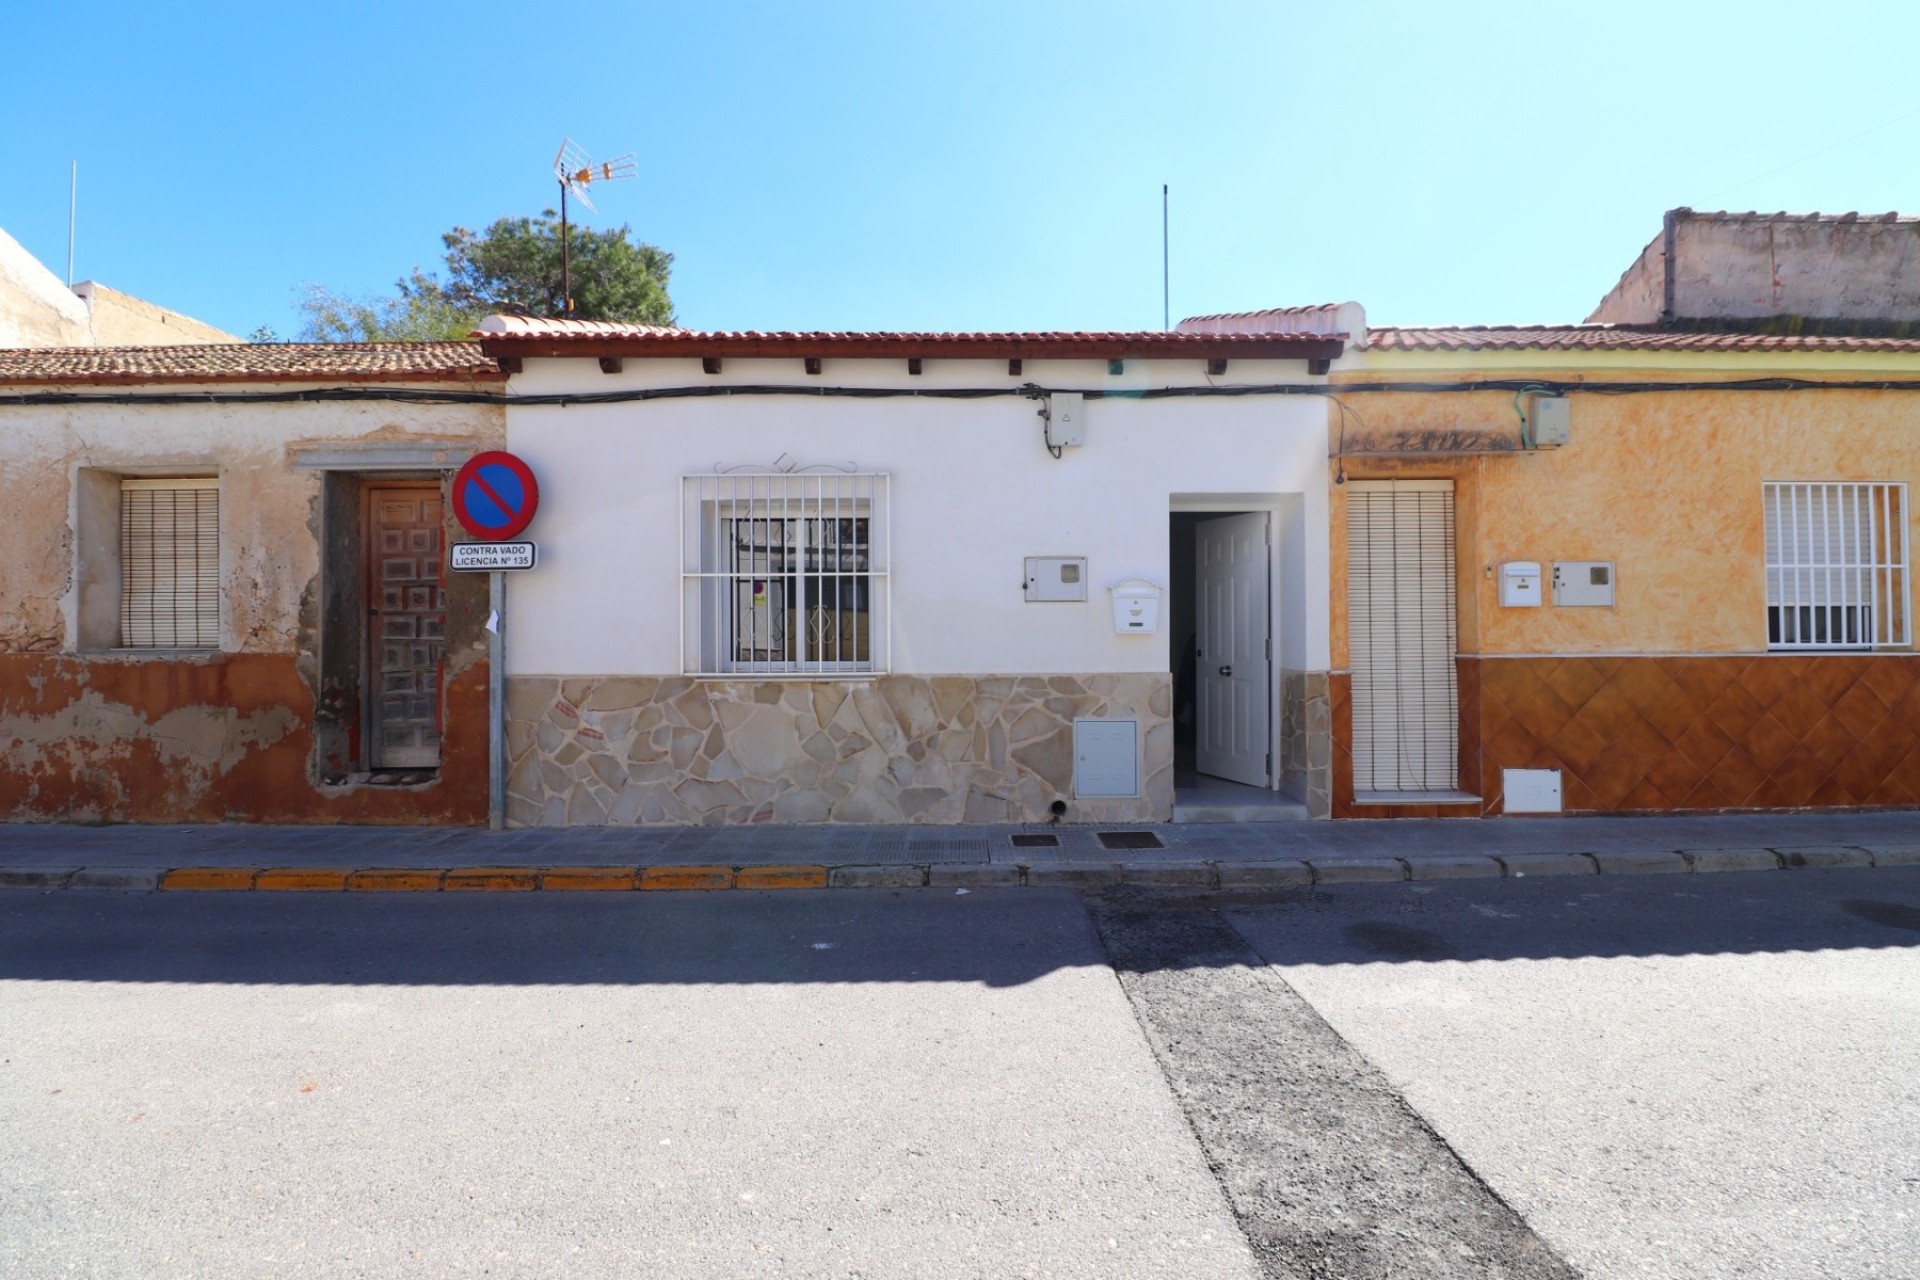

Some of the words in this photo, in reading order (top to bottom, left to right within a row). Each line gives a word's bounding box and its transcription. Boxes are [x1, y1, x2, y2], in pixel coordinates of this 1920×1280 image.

[460, 546, 498, 555] CONTRA
[500, 546, 526, 554] VADO
[456, 558, 498, 566] LICENCIA
